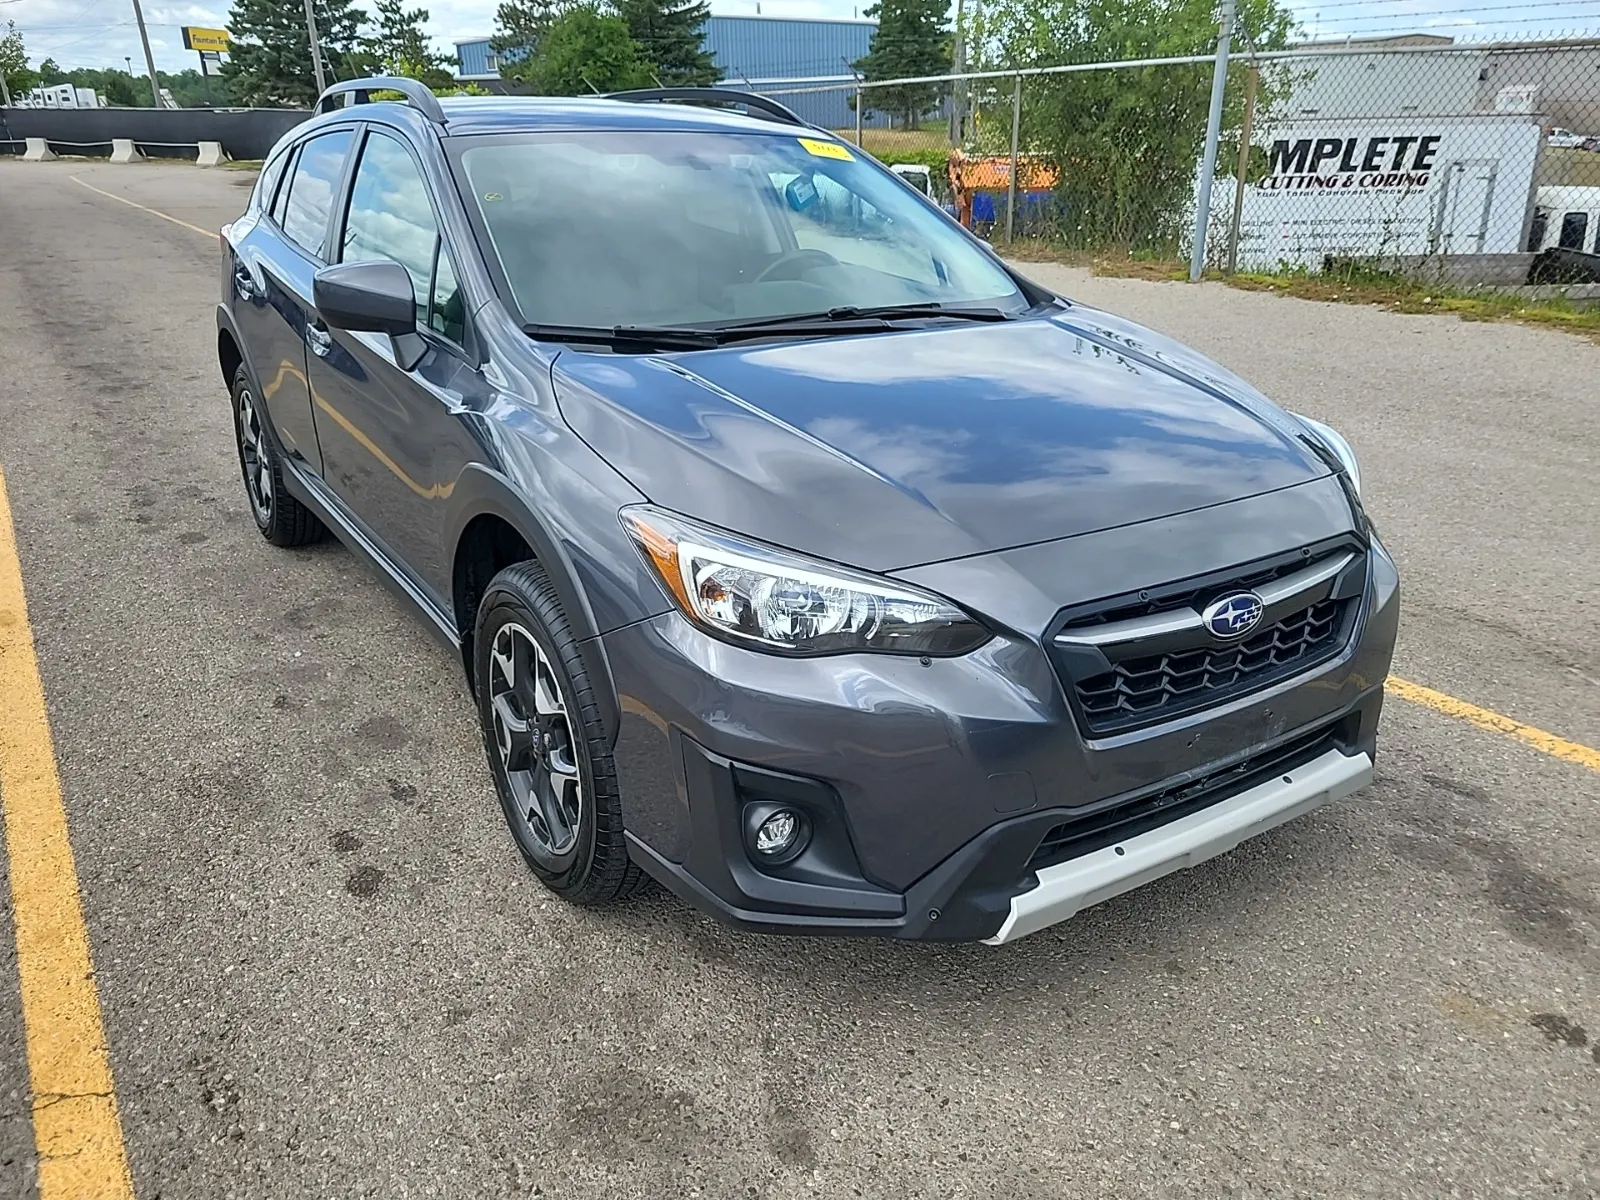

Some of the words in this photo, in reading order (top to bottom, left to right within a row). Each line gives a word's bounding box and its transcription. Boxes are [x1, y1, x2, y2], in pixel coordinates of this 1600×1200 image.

[192, 34, 217, 43] Fountain
[1269, 135, 1442, 174] MPLETE
[1259, 174, 1338, 190] CUTTING
[1341, 174, 1354, 188] &
[1358, 172, 1430, 188] CORING
[1318, 189, 1370, 197] Concrete
